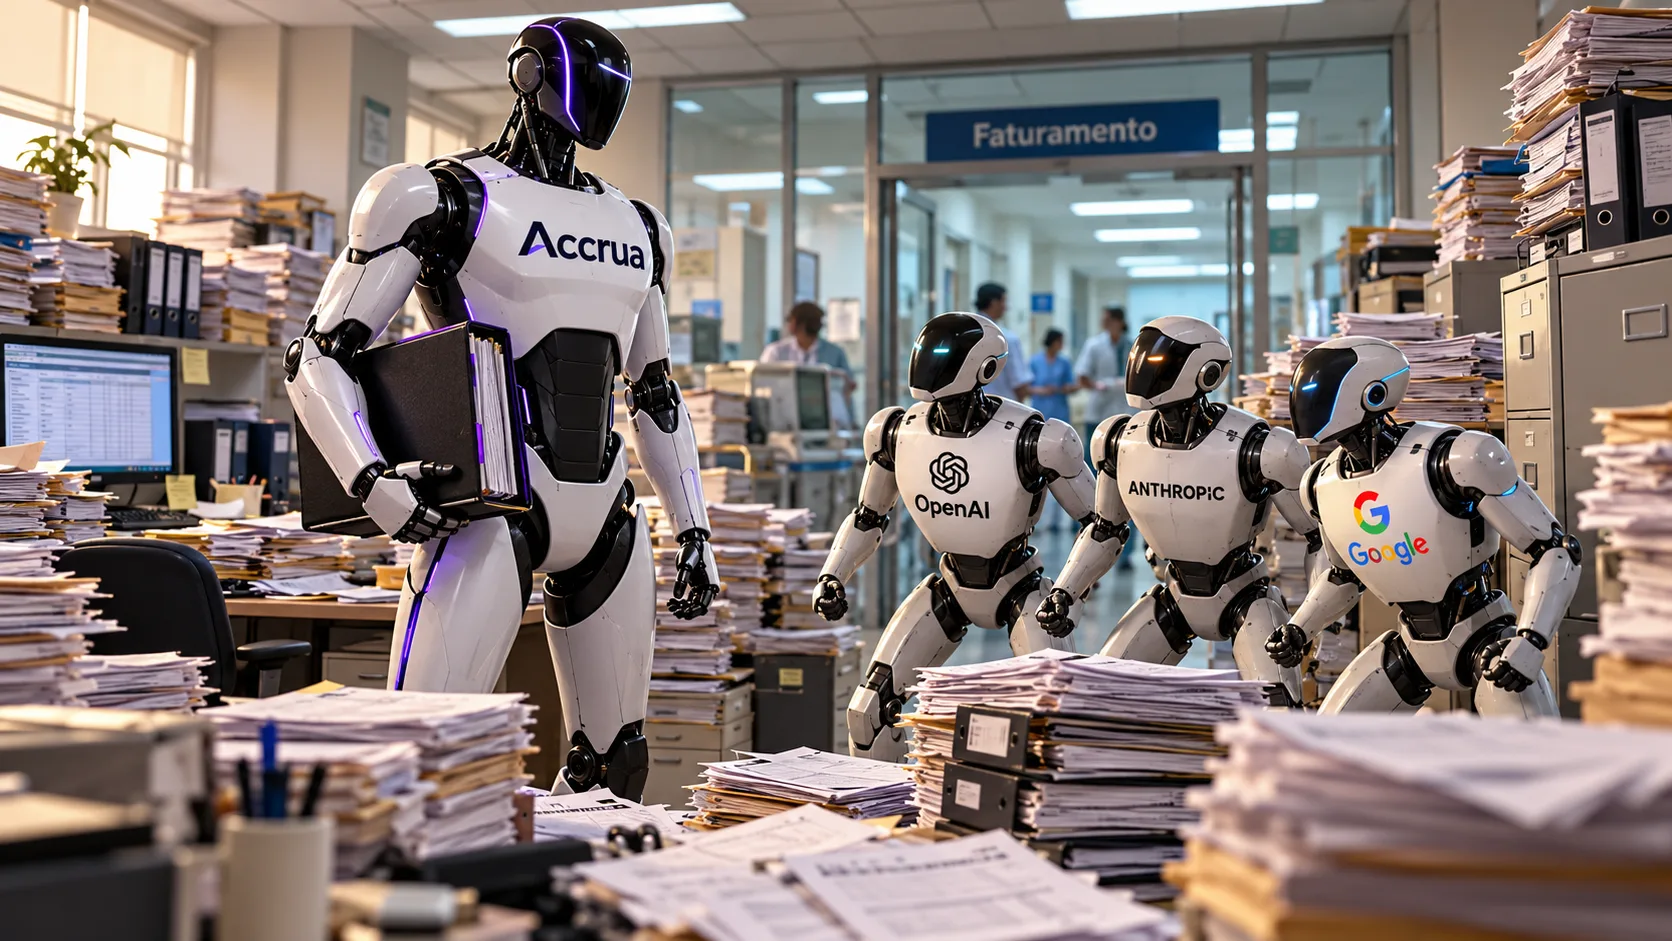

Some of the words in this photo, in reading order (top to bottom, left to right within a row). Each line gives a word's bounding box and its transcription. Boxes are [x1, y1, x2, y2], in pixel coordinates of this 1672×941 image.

[973, 117, 1158, 149] Faturamento
[518, 220, 645, 270] Accrua
[915, 494, 990, 519] OpenAI
[1348, 532, 1429, 566] Google
